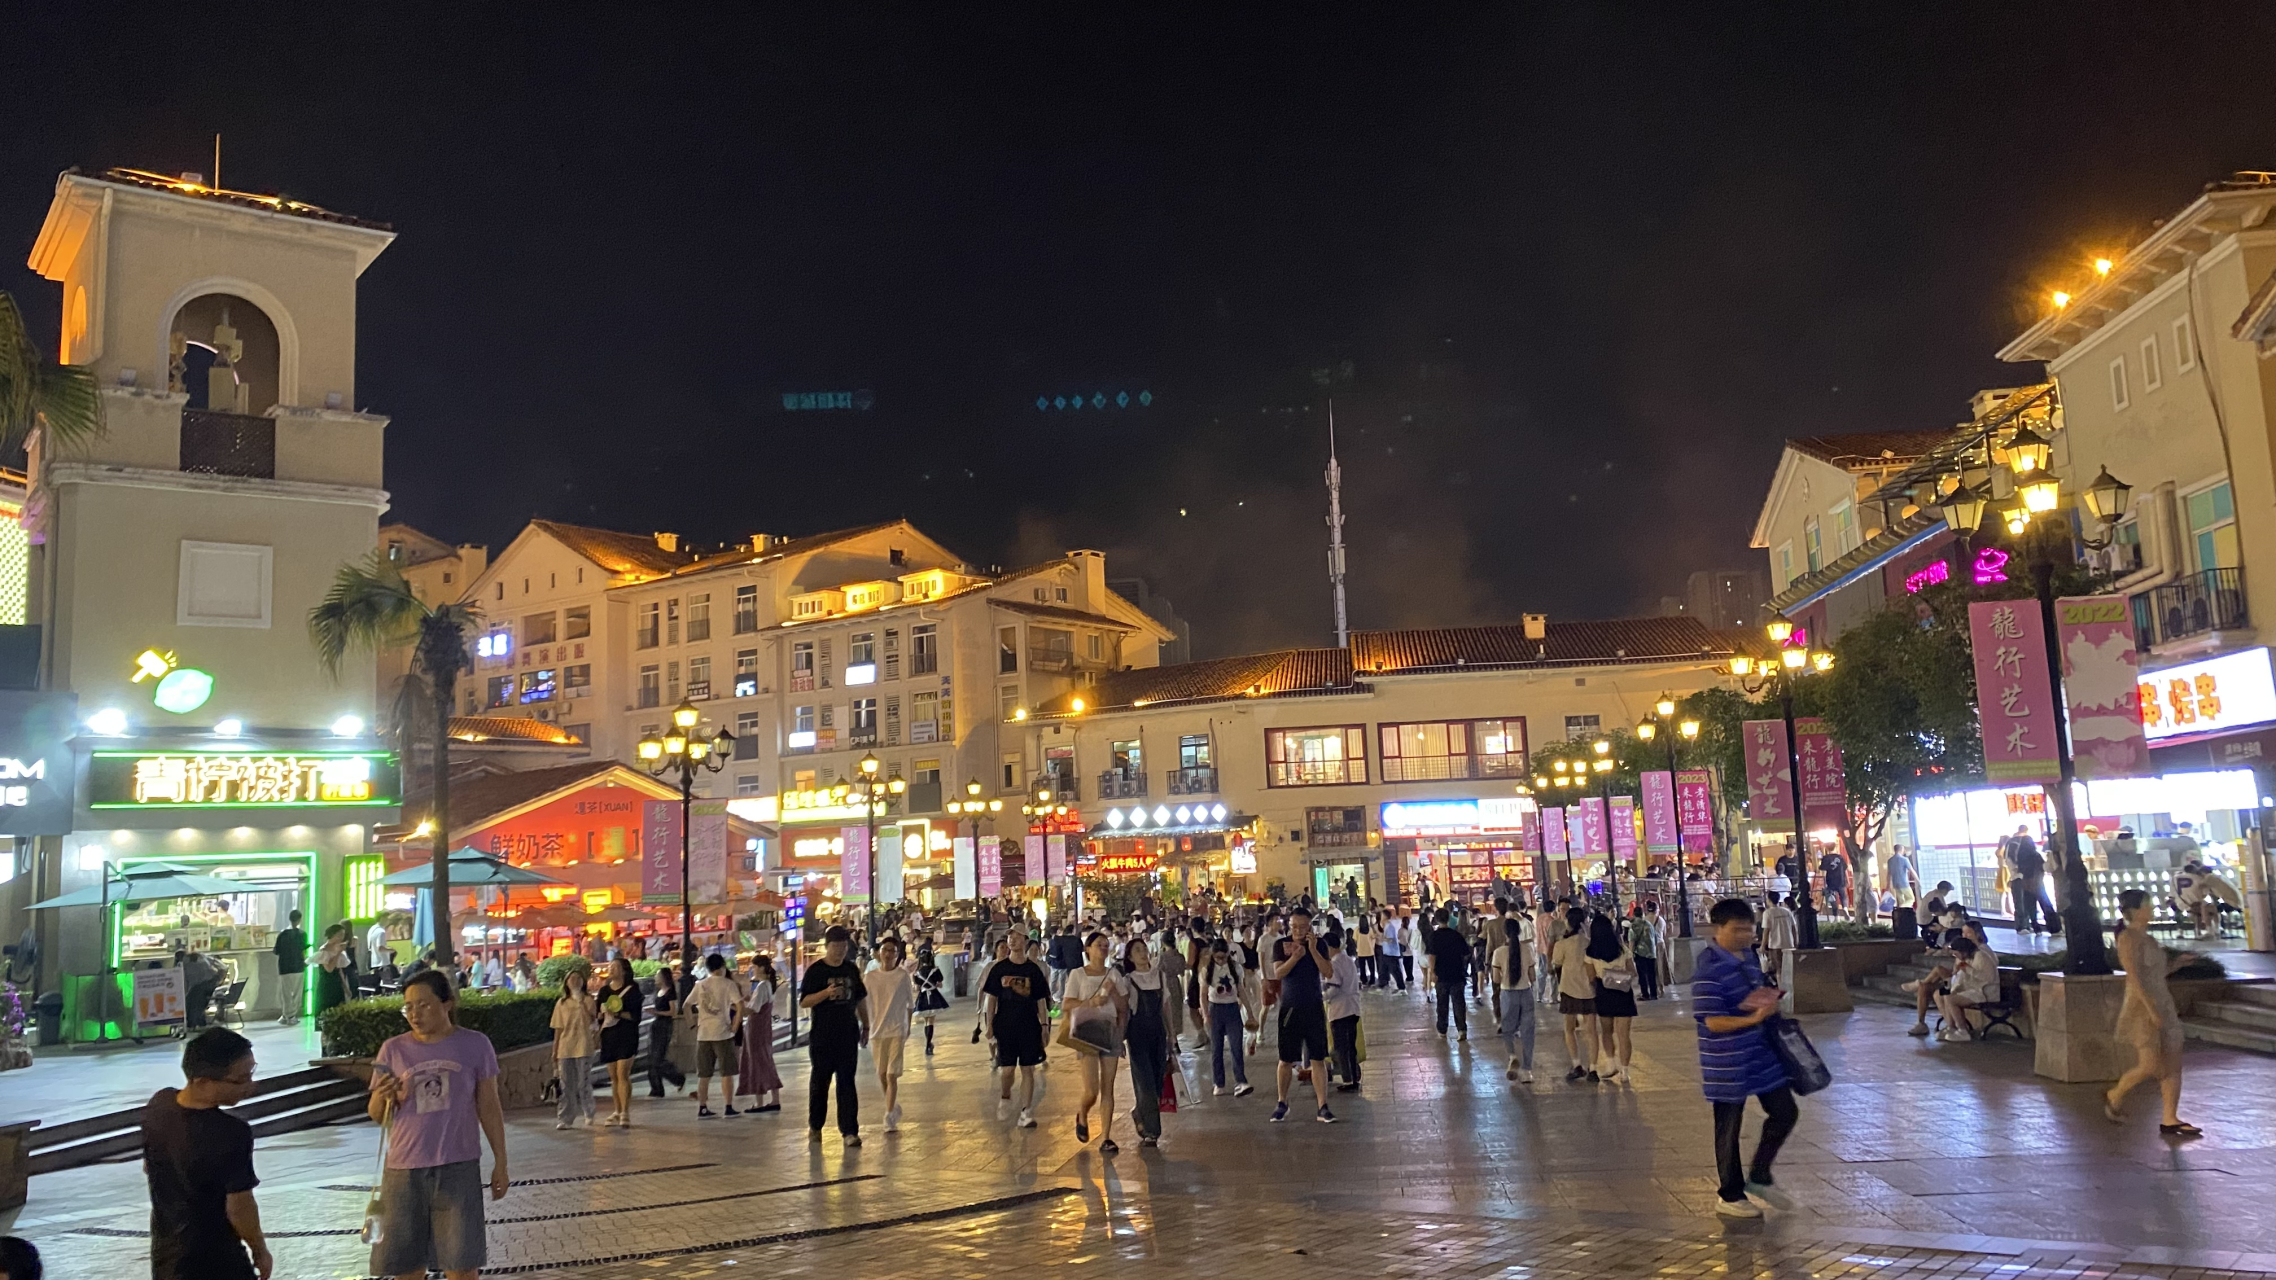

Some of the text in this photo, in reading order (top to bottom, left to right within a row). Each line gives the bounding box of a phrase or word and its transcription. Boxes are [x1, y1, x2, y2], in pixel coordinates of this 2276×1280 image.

[2062, 603, 2127, 625] 2022
[1988, 607, 2037, 757] 龍行艺术
[1649, 774, 1669, 843] 龍行艺术
[1678, 774, 1706, 784] 2023
[651, 803, 672, 891] 龍行艺术
